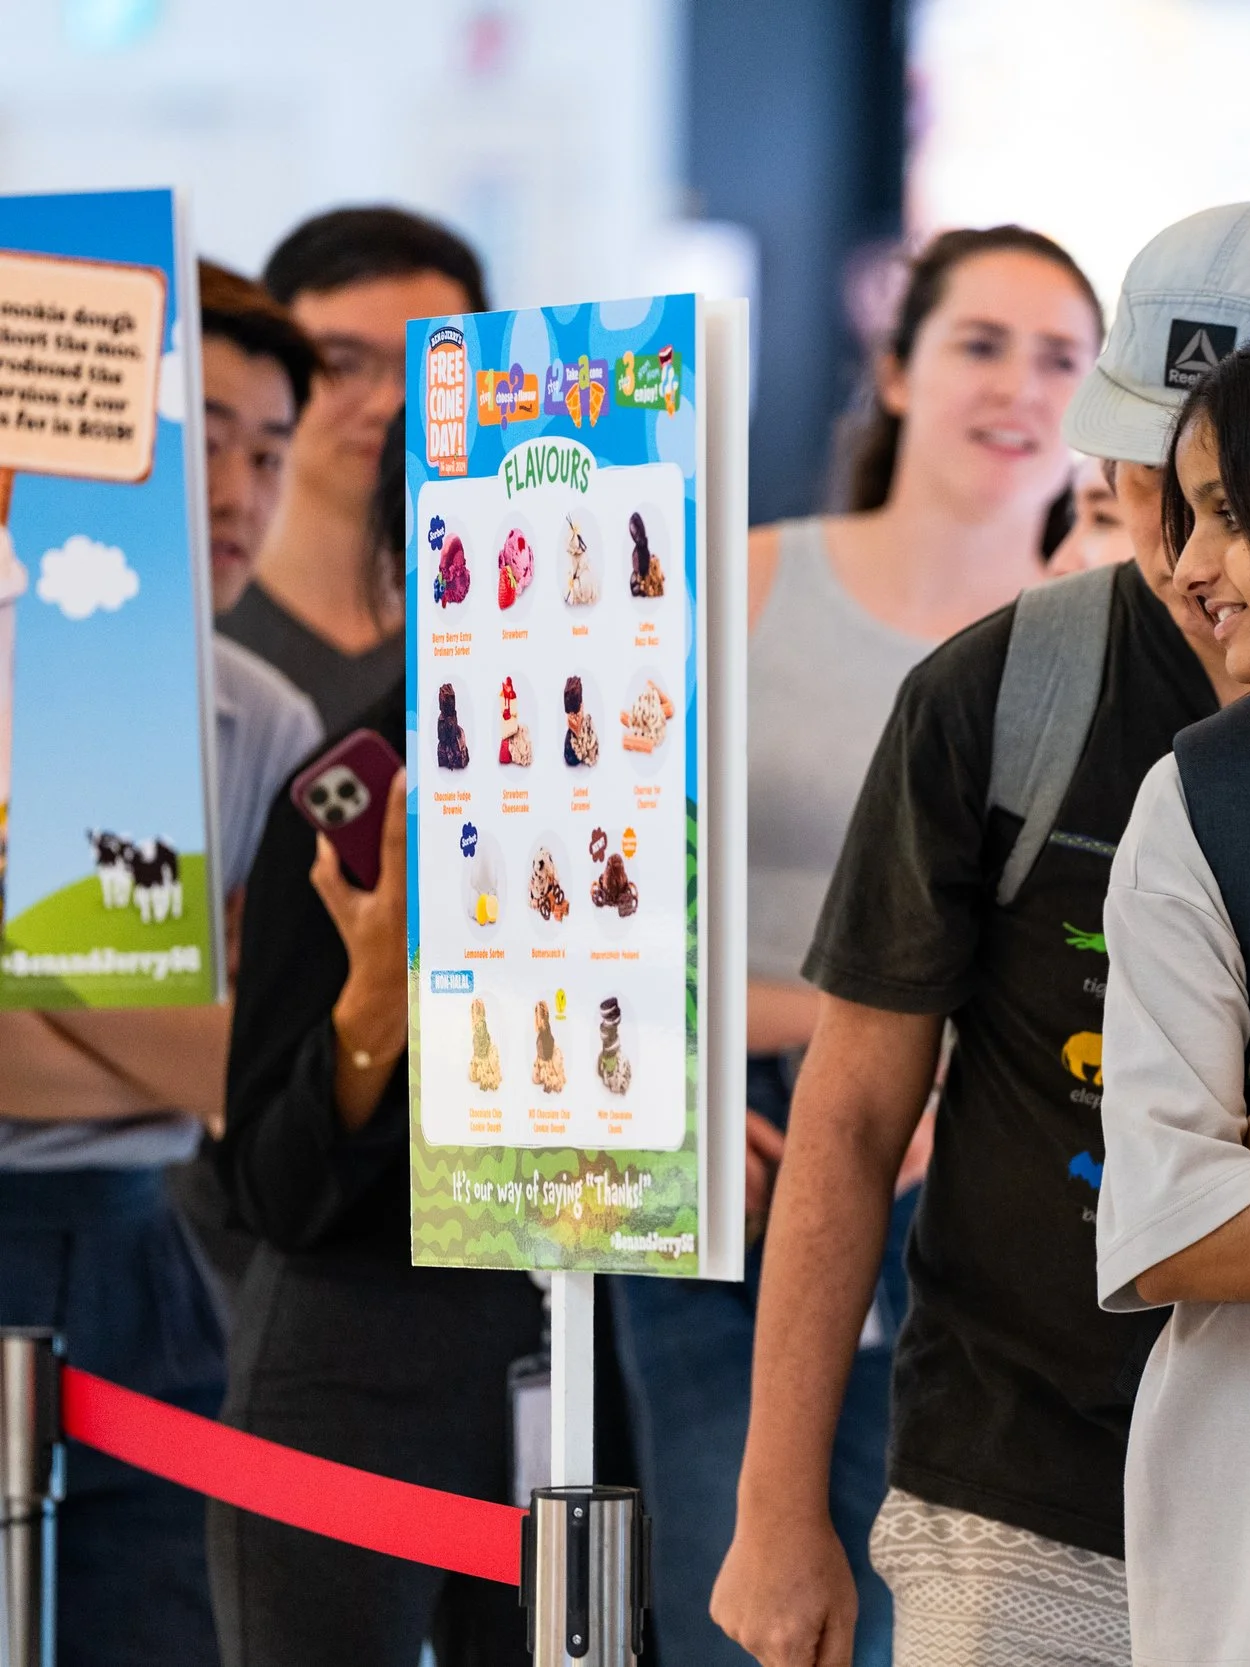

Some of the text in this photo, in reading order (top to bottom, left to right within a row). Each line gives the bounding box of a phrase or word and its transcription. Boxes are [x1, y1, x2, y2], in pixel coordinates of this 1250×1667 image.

[73, 306, 135, 336] dough
[56, 334, 88, 351] the
[88, 365, 121, 385] the
[429, 350, 463, 385] FREE
[622, 350, 635, 396] 3
[1169, 369, 1201, 384] Ree
[485, 368, 494, 411] 1
[496, 392, 513, 403] choose
[518, 390, 536, 402] flavour
[552, 358, 564, 402] 2
[590, 368, 603, 379] cone
[67, 390, 88, 408] of
[95, 397, 128, 412] our
[634, 383, 658, 403] enjoy!
[430, 386, 463, 421] CONE
[430, 422, 463, 457] DAY!
[504, 445, 591, 499] FLAVOURS
[429, 527, 445, 542] Sorbet
[432, 633, 445, 644] Berry
[446, 632, 459, 643] Berry
[502, 629, 528, 640] Strawberry
[455, 646, 470, 656] Sorbet
[434, 790, 471, 801] Chocolate Fudge
[502, 789, 528, 800] Strawberry
[443, 804, 463, 815] Brownie
[461, 834, 477, 848] Sorbet
[464, 948, 505, 959] Lemonade Sorbet
[453, 1170, 470, 1204] It's
[474, 1181, 493, 1202] our
[497, 1181, 522, 1215] way
[526, 1169, 539, 1206] of
[543, 1174, 582, 1220] saying
